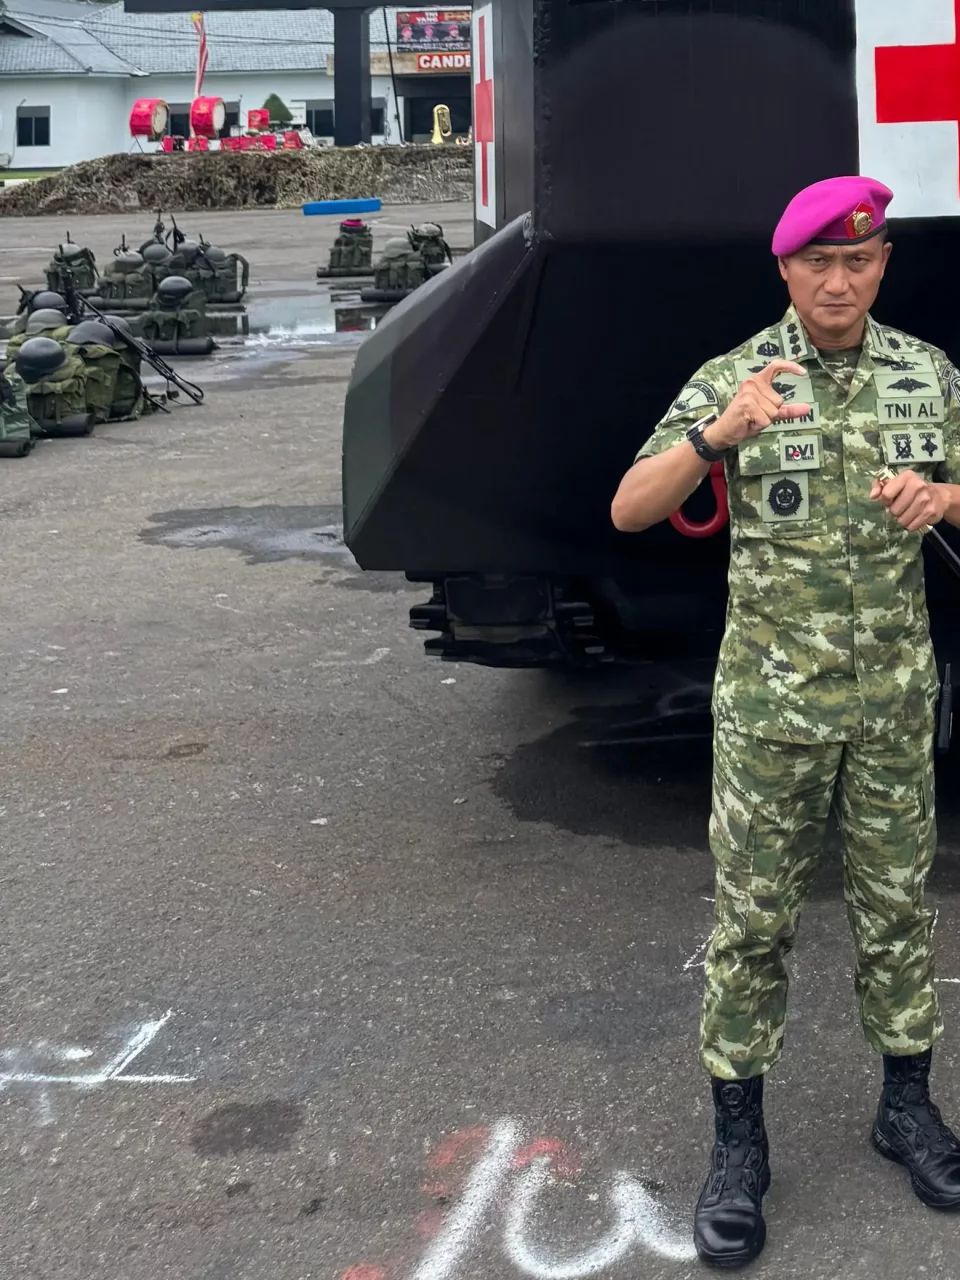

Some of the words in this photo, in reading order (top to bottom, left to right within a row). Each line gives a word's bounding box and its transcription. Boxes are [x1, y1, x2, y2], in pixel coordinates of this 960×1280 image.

[884, 403, 911, 418] TNI
[918, 401, 938, 417] AL
[785, 443, 814, 459] DVI
